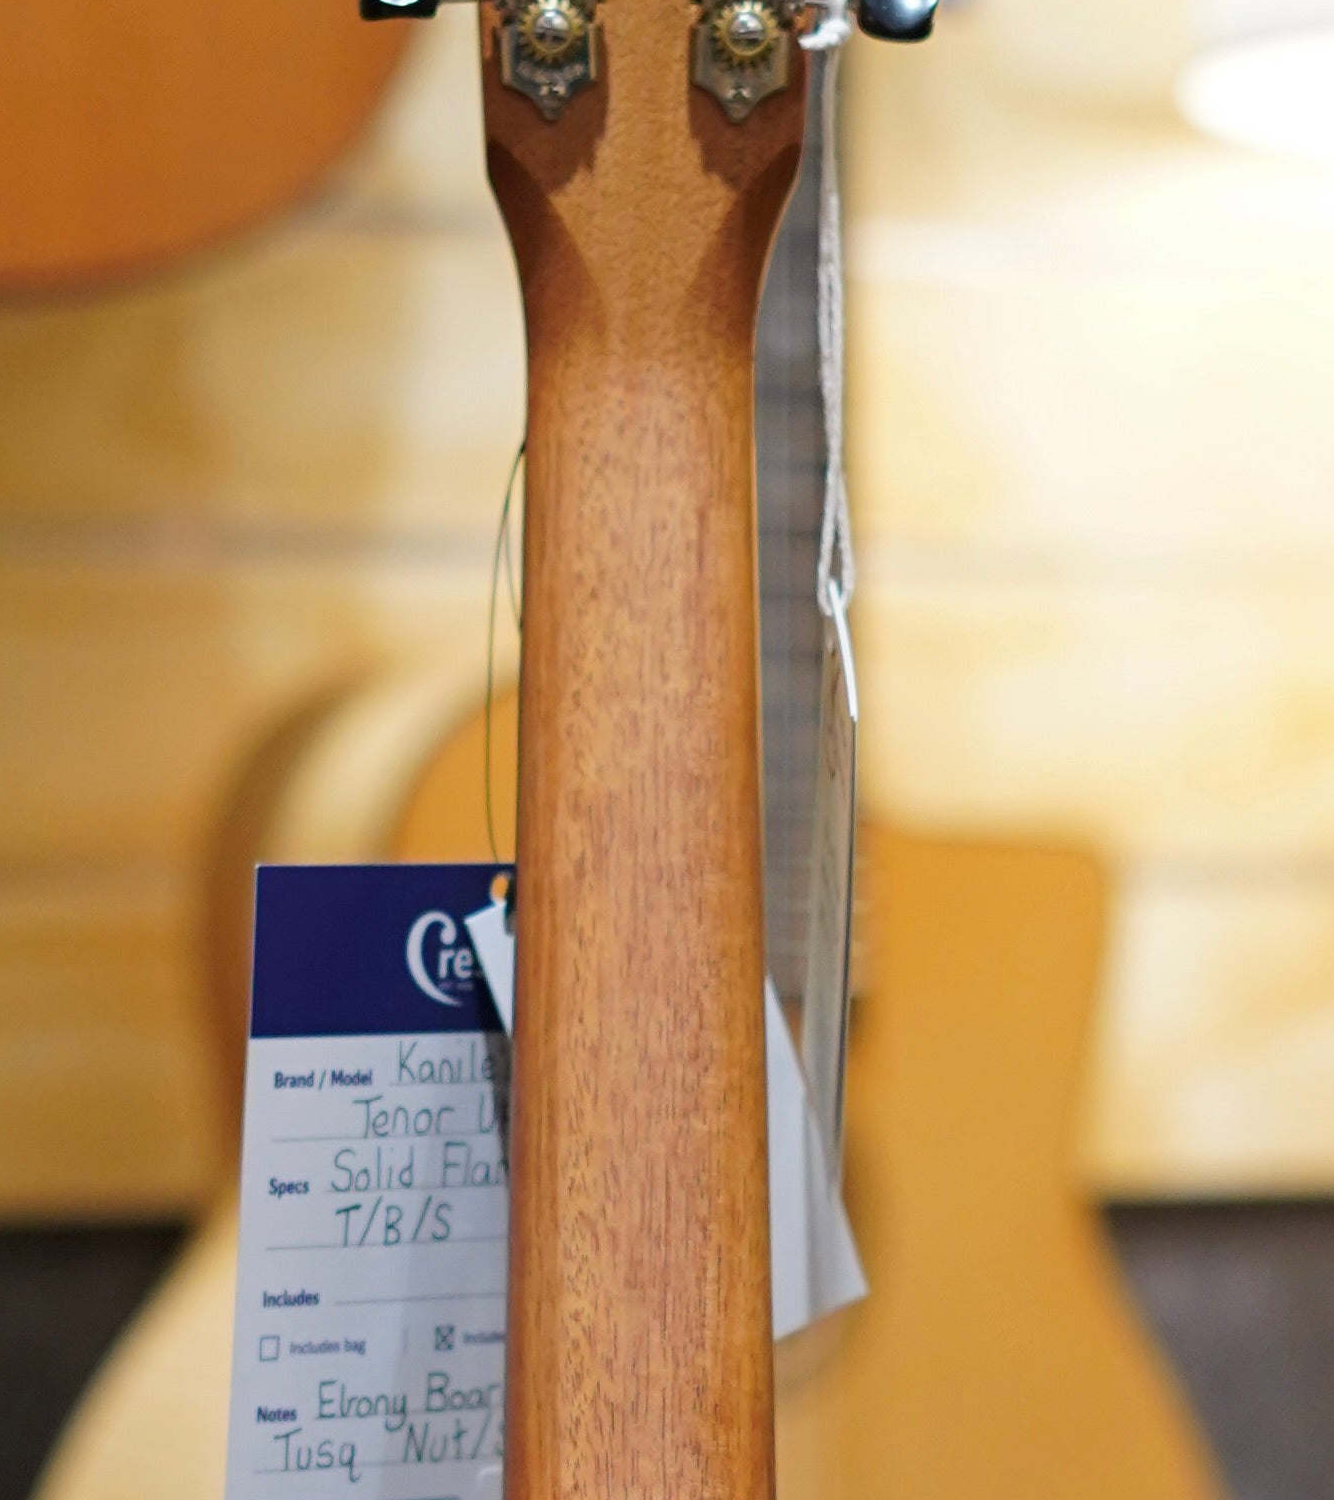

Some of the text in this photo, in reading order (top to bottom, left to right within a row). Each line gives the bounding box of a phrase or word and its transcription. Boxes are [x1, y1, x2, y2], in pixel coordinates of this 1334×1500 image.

[406, 910, 476, 1007] Cre
[274, 1069, 373, 1091] Brand / Model
[353, 1095, 455, 1139] Tenor
[331, 1146, 414, 1192] Solid
[269, 1178, 309, 1197] Specs
[335, 1195, 452, 1248] T/B/S
[262, 1289, 320, 1308] Includes
[257, 1406, 298, 1423] Notes
